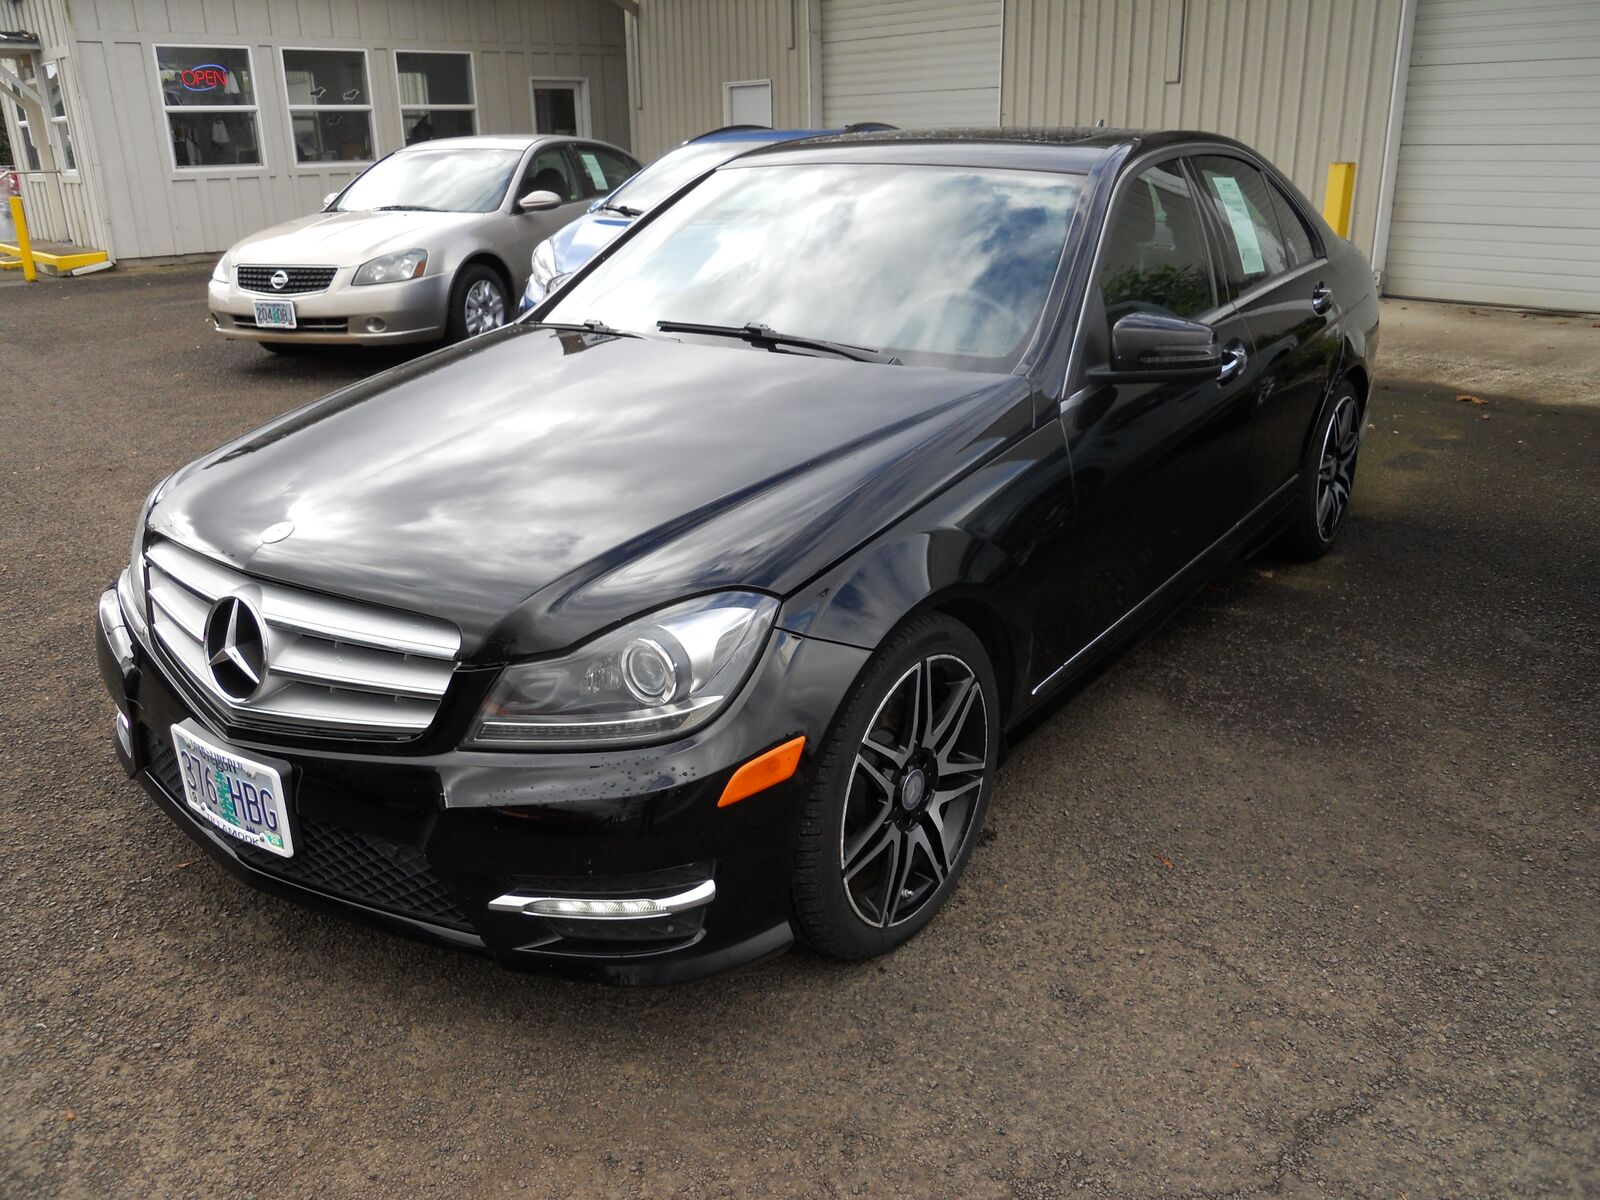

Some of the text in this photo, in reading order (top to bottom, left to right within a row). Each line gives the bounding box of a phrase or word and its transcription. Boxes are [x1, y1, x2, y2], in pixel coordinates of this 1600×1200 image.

[181, 69, 228, 86] OPEN
[256, 308, 272, 321] 204
[181, 750, 278, 831] 376 HBG
